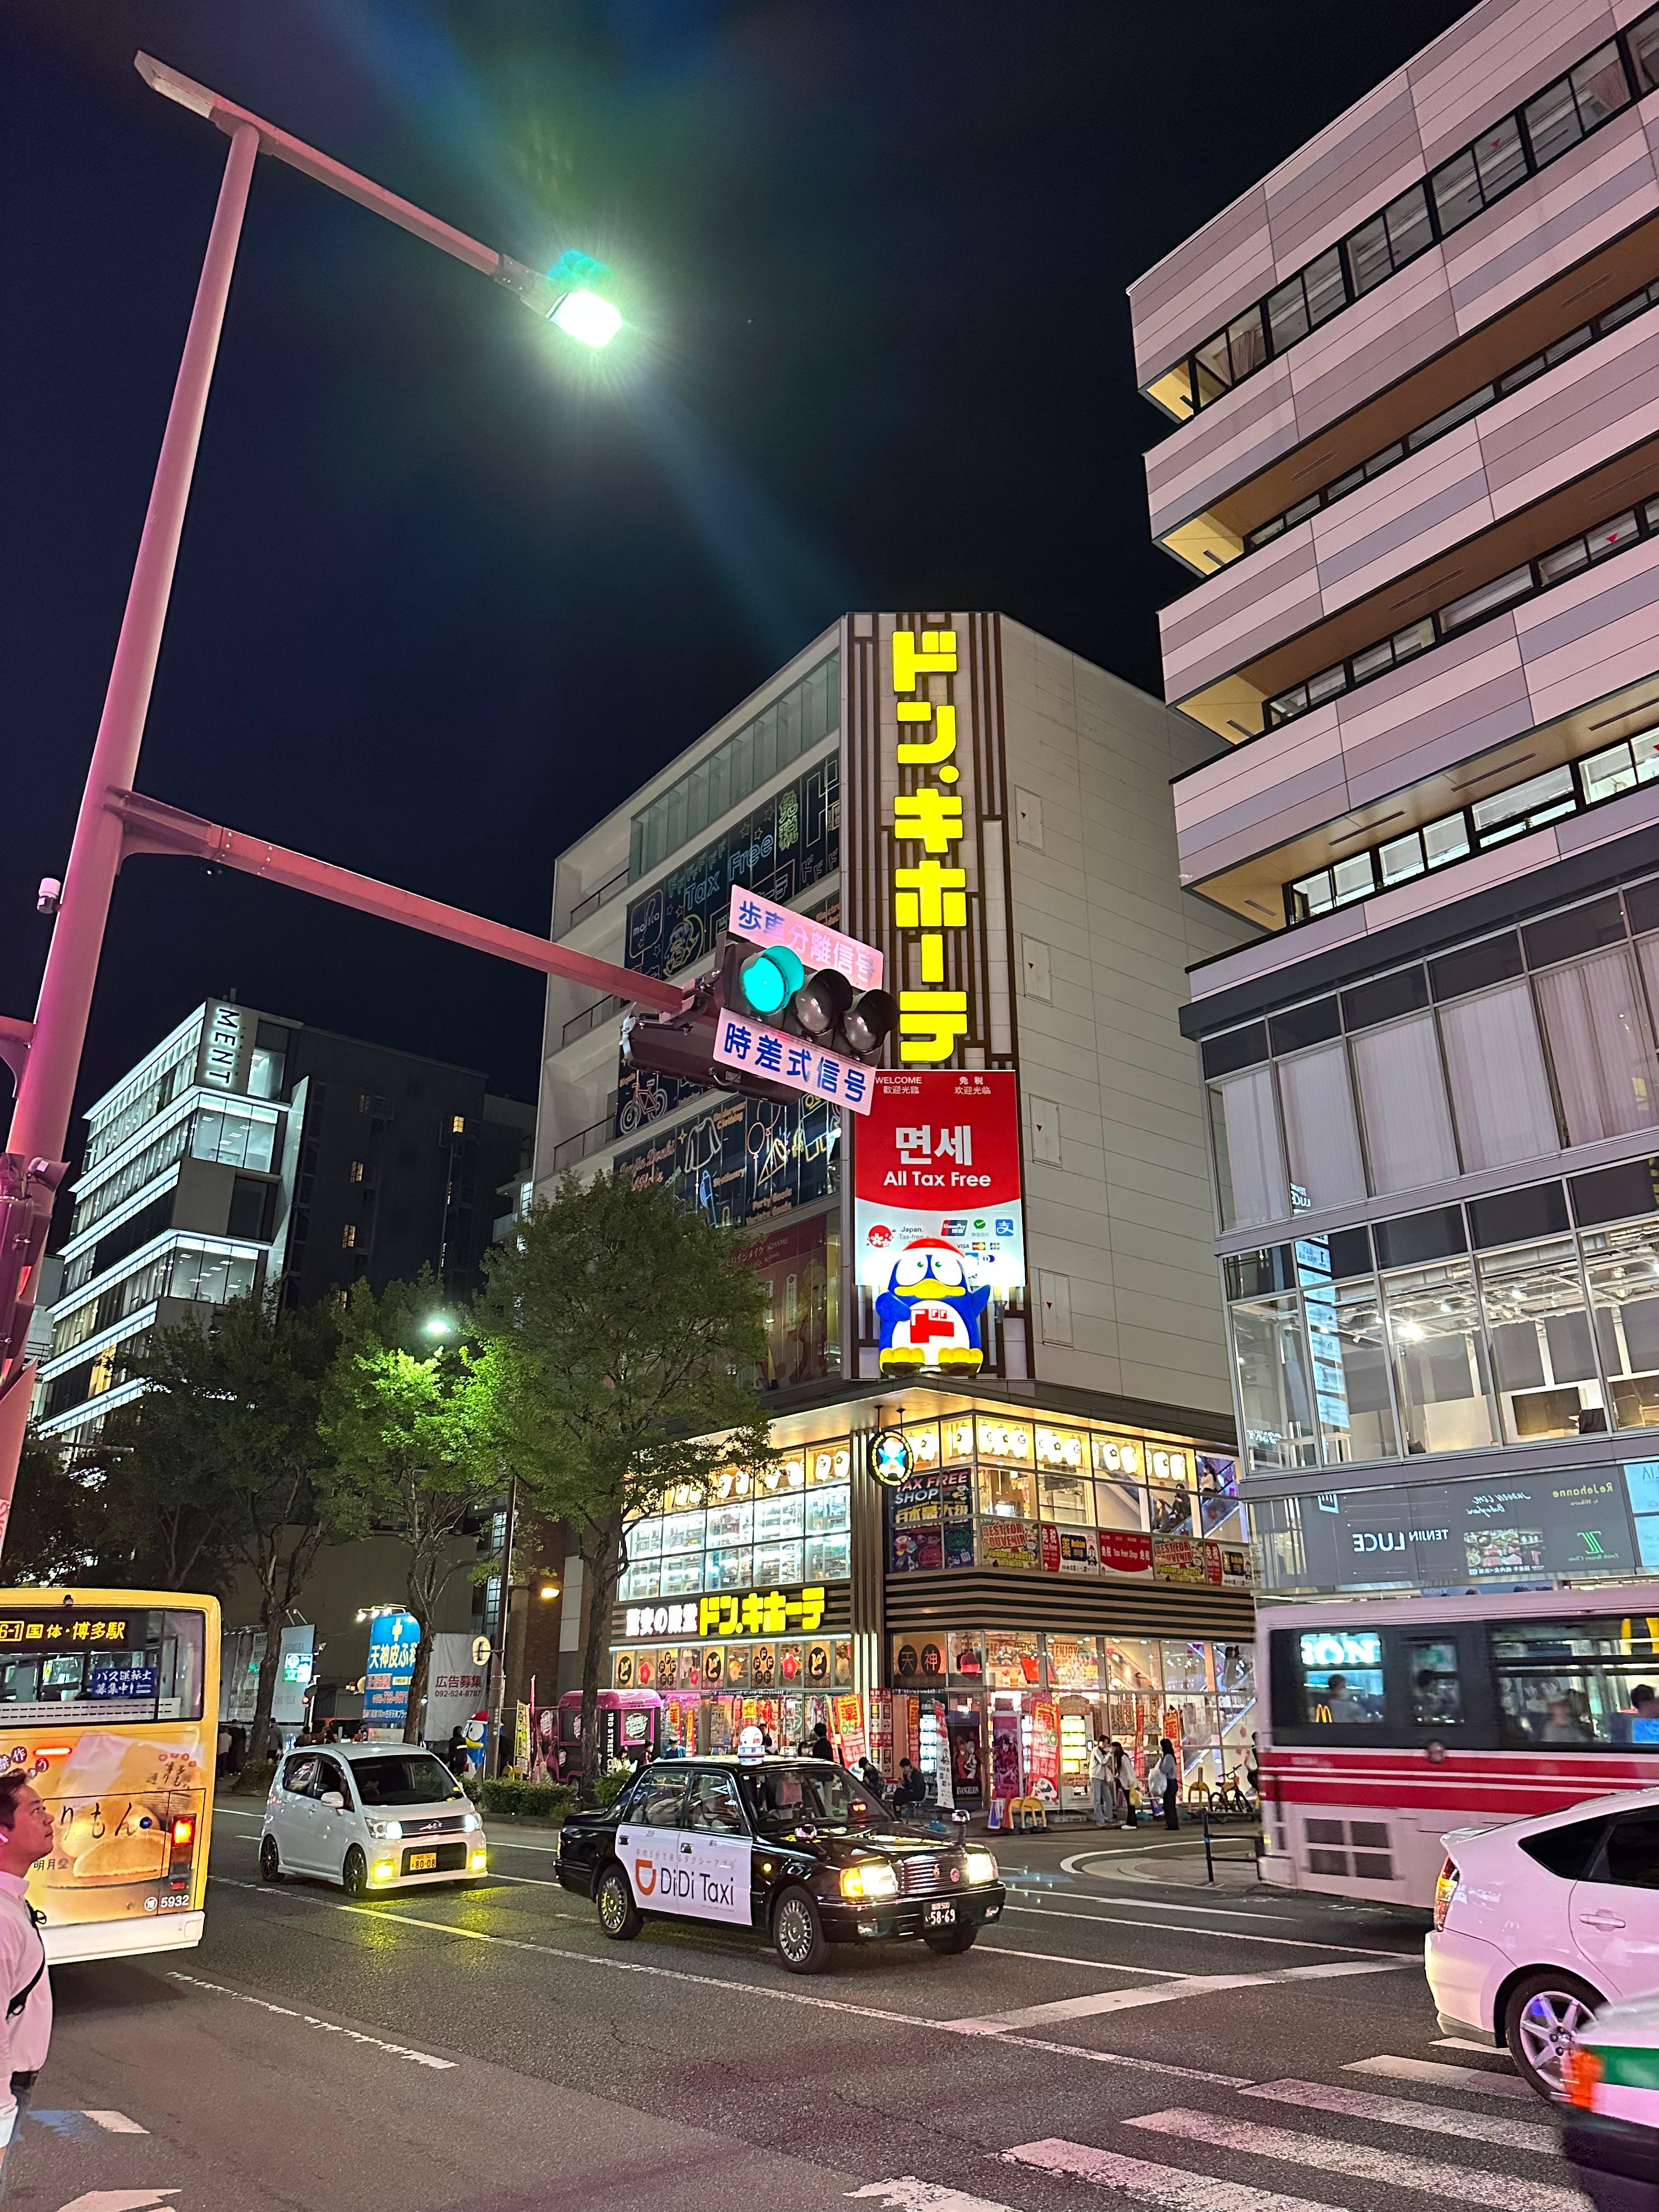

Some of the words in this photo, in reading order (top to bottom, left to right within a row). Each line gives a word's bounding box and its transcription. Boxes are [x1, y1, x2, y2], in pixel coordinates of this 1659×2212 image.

[778, 789, 799, 851] 免税
[686, 870, 720, 911] Tax
[729, 834, 774, 882] Free
[738, 899, 876, 989] 歩車分離信号
[208, 1008, 240, 1084] MENT
[724, 1022, 866, 1103] 時差式信号
[883, 1086, 919, 1094] 歡迎光臨
[955, 1086, 991, 1095] 欢迎光临
[895, 1125, 973, 1166] 면세
[883, 1171, 907, 1186] All
[912, 1171, 945, 1187] Tax
[951, 1172, 991, 1187] Free
[927, 1471, 968, 1488] FREE
[895, 1488, 939, 1504] SHOP
[983, 1525, 1005, 1536] BEST
[1006, 1523, 1023, 1534] FOR
[983, 1534, 1027, 1549] SOUVENIR
[1155, 1543, 1174, 1554] BEST
[1175, 1541, 1190, 1553] FOR
[1008, 1552, 1035, 1561] products
[1120, 1549, 1129, 1558] Free
[1128, 1550, 1138, 1560] Shop
[1007, 1559, 1023, 1568] Japan
[26, 1621, 125, 1640] 国体・博多駅
[1055, 1645, 1078, 1658] ENJOY
[901, 1650, 938, 1672] 天神
[97, 1670, 152, 1681] バス運転士
[435, 1675, 482, 1689] 広告募集
[415, 1859, 436, 1869] 80-08
[661, 1867, 695, 1899] DiDi
[699, 1873, 734, 1906] Taxi
[160, 1895, 189, 1908] 5932
[930, 1909, 956, 1925] 58-69
